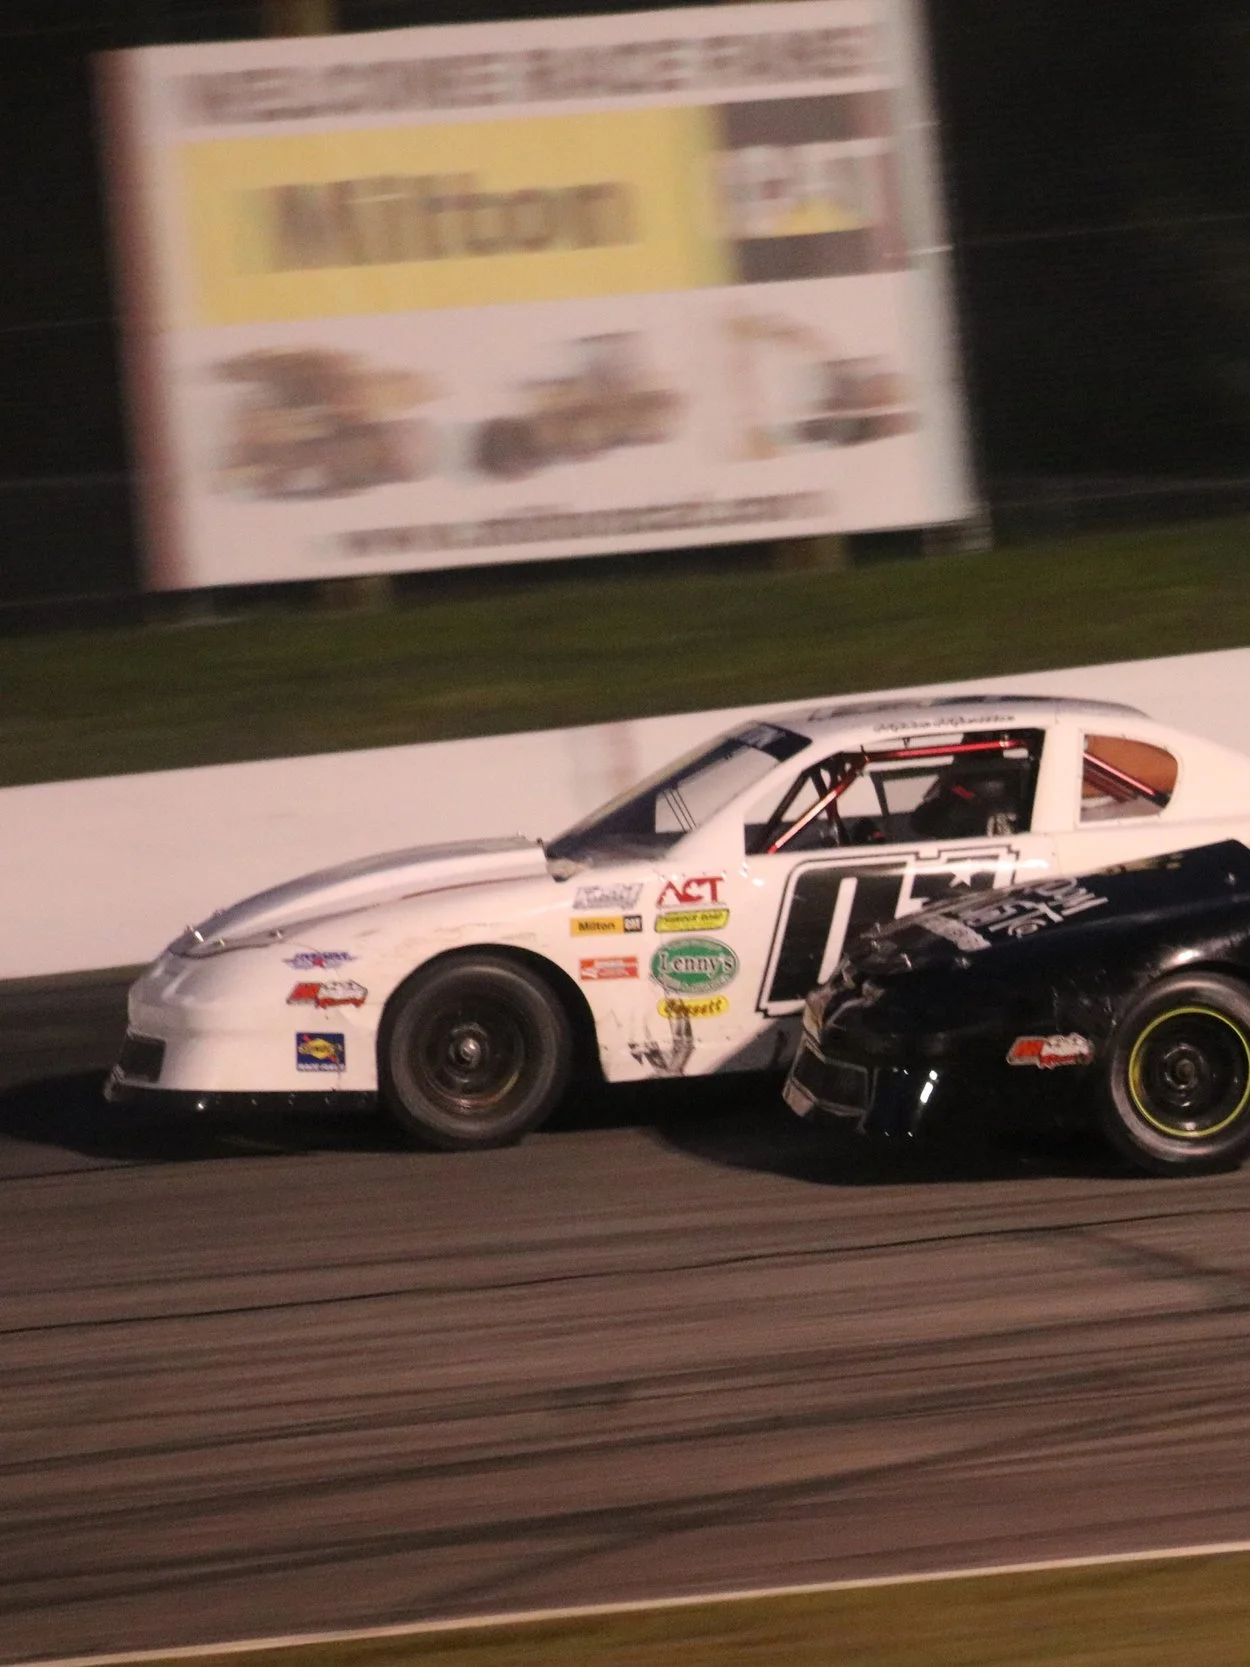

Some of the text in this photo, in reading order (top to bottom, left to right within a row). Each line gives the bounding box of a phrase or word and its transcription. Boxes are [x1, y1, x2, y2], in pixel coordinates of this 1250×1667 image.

[262, 172, 638, 272] Milton
[656, 877, 724, 906] ACT
[578, 921, 616, 931] Milton
[660, 948, 735, 979] Lenny's
